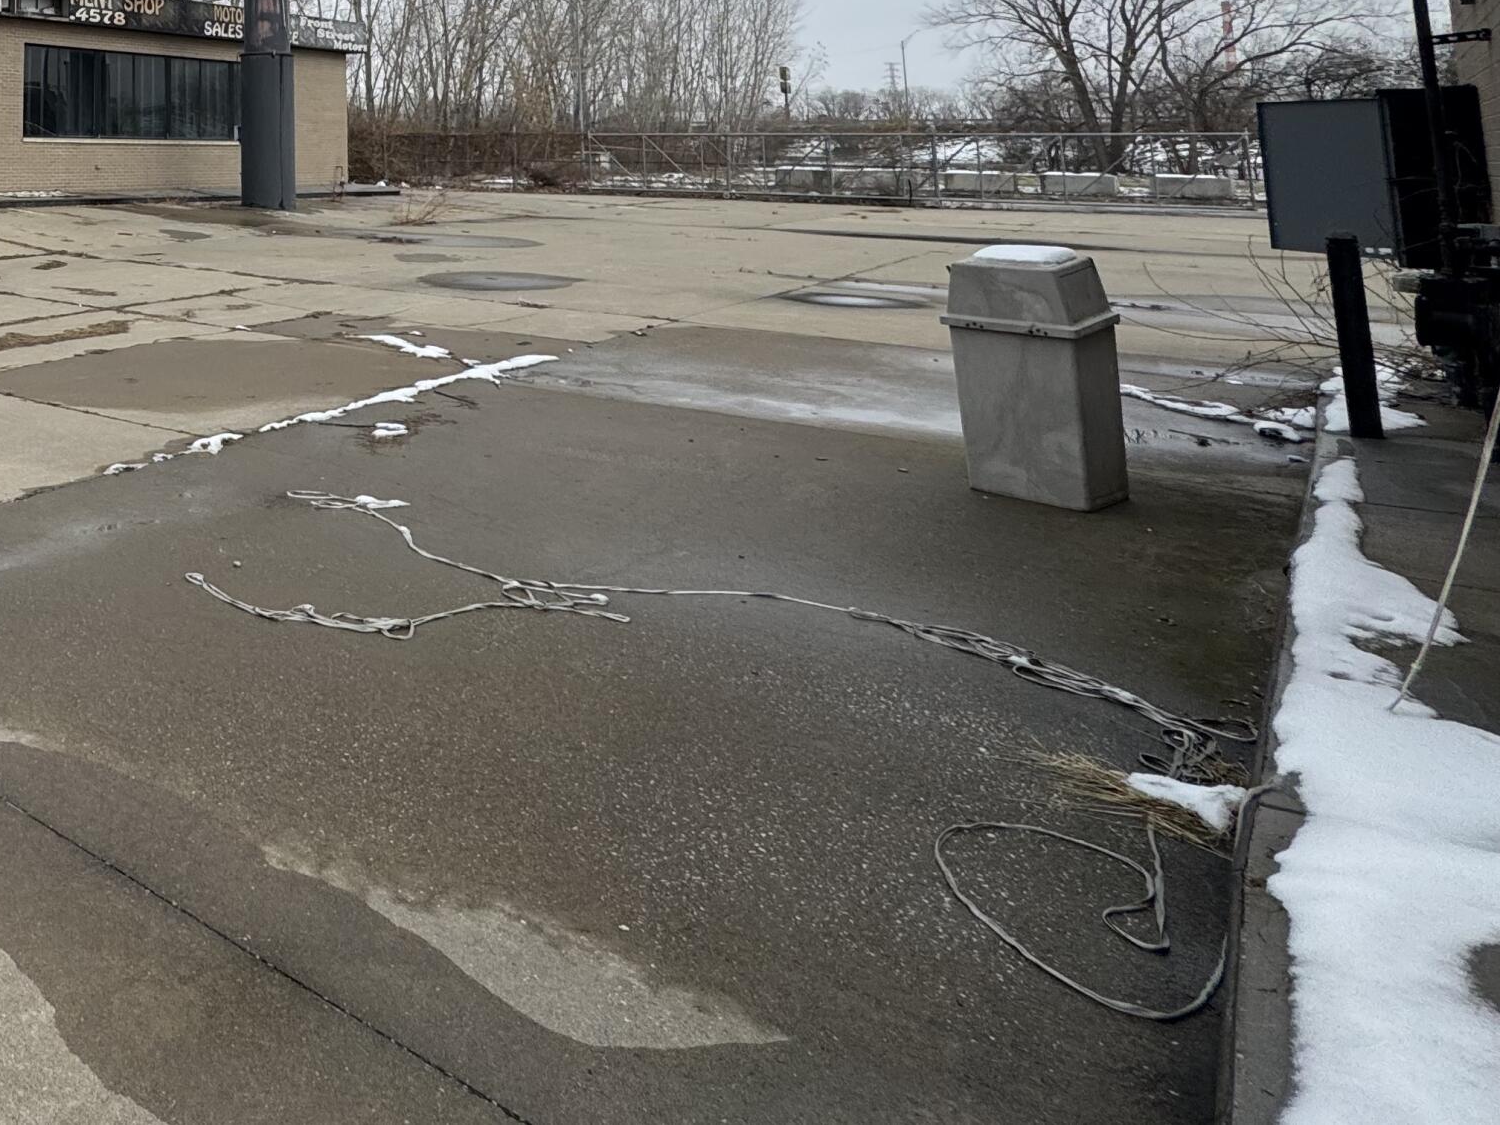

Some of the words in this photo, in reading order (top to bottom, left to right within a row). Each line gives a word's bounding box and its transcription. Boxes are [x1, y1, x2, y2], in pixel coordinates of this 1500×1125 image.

[69, 7, 127, 26] .4578
[299, 16, 335, 30] Front
[204, 20, 244, 39] SALES
[316, 28, 356, 41] Street
[333, 39, 368, 53] Motors
